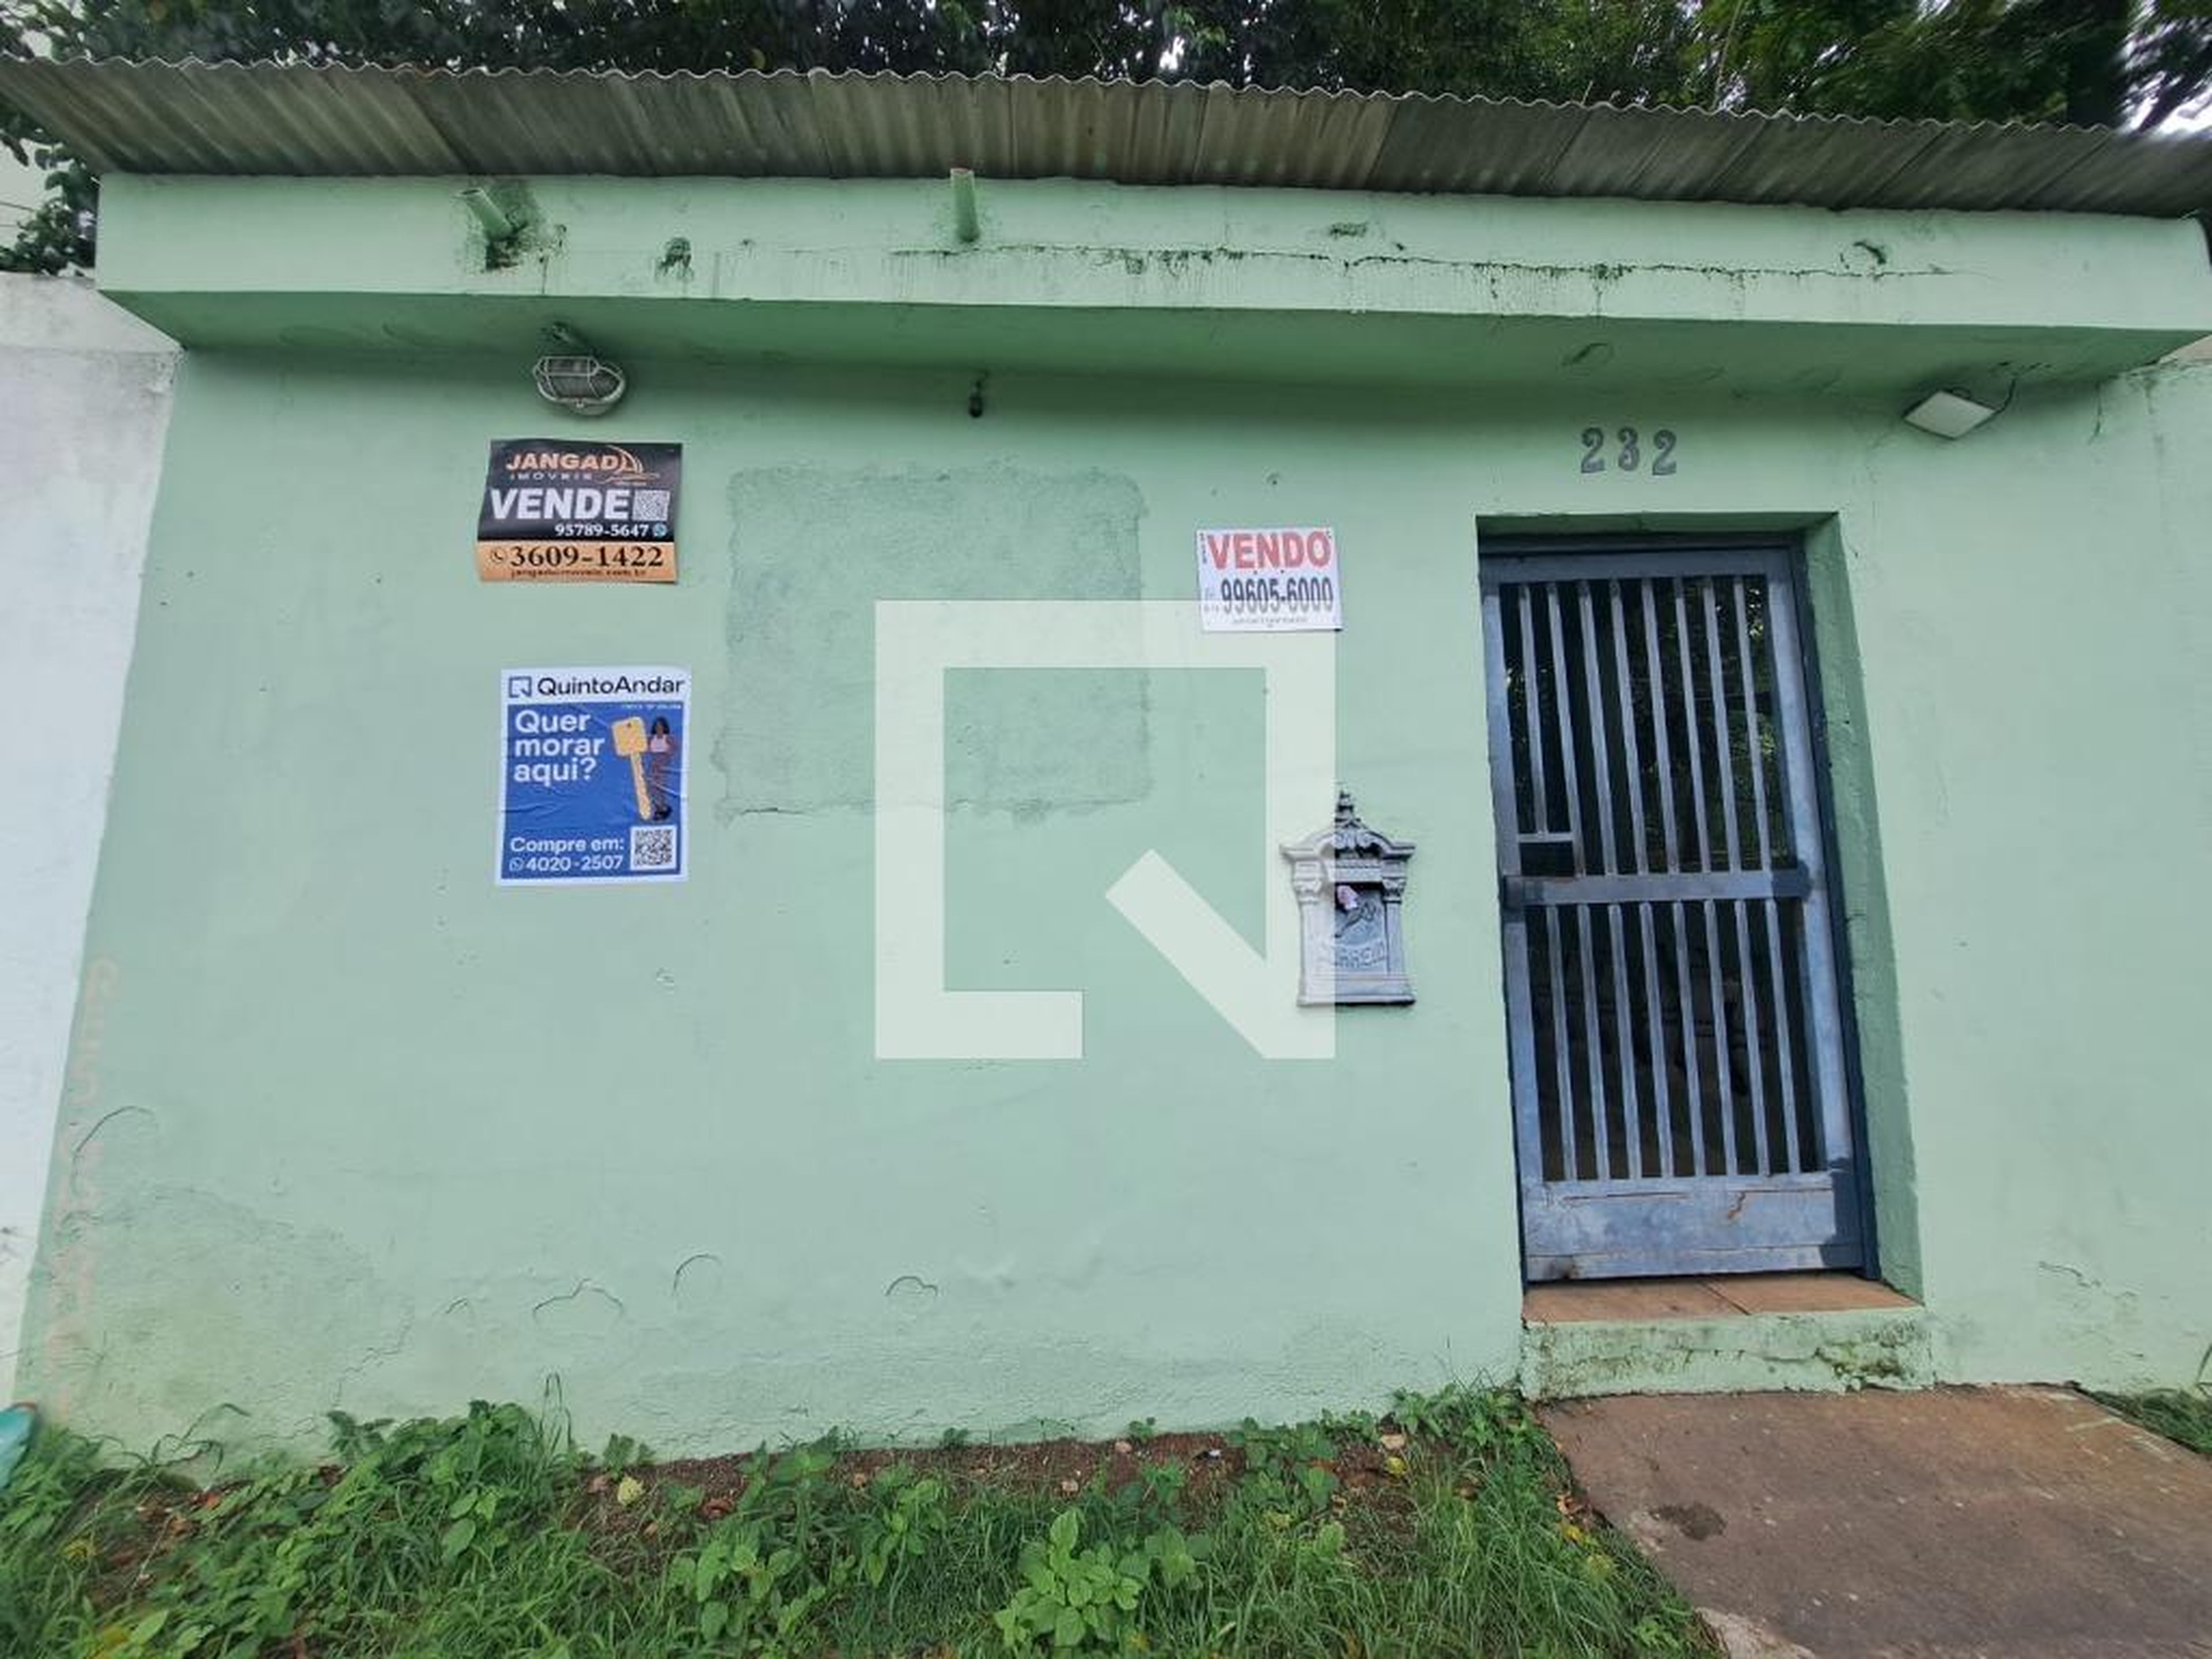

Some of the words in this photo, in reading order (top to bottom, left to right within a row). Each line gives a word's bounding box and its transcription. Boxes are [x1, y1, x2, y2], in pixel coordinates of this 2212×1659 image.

[1581, 427, 1676, 476] 232
[490, 488, 630, 520] VENDE
[554, 524, 649, 537] 95789-5647
[510, 546, 664, 567] 3609-1422
[1208, 531, 1331, 569] VENDO
[1221, 577, 1333, 613] 99605-6000
[537, 676, 684, 695] QuintoAndar
[515, 709, 591, 734] Quer
[515, 736, 604, 756] morar
[513, 757, 597, 787] aqui?
[510, 837, 585, 855] Compre
[591, 838, 624, 851] em:
